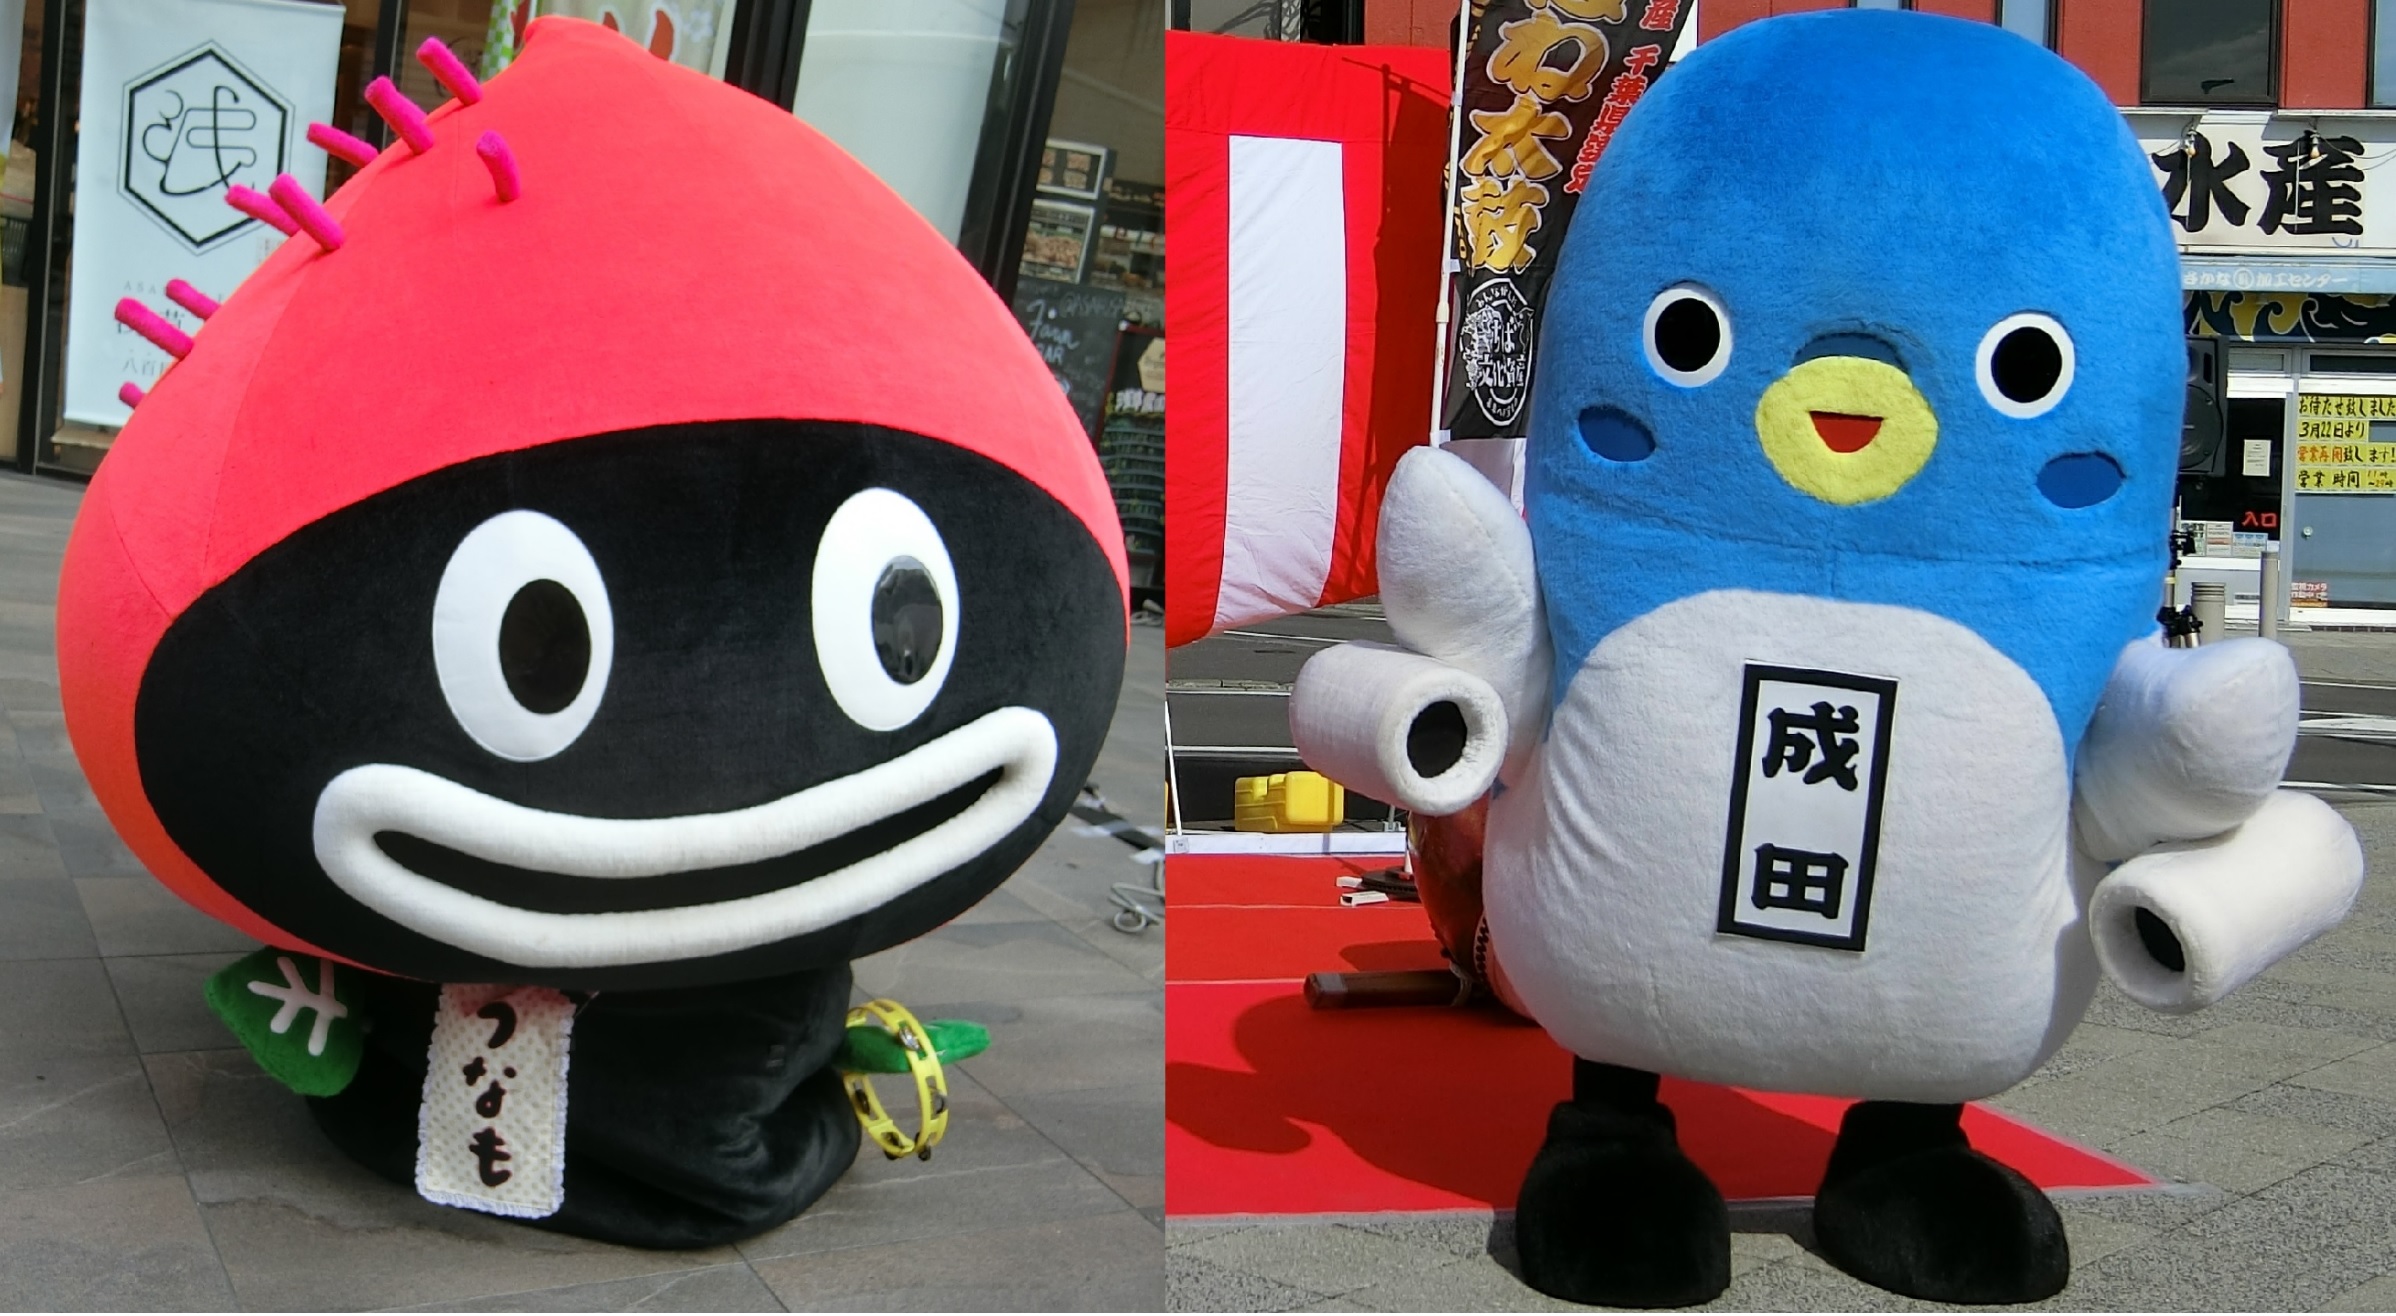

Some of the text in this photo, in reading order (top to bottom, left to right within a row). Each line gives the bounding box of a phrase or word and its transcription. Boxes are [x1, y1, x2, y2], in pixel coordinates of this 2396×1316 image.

[2152, 129, 2366, 236] 水産
[2298, 396, 2396, 418] お待たせ致しました
[2298, 421, 2365, 439] 3月22日より
[2298, 470, 2360, 488] 営業時間
[2242, 511, 2277, 528] 入口
[1750, 701, 1860, 919] 成田
[462, 1001, 517, 1187] つなも
